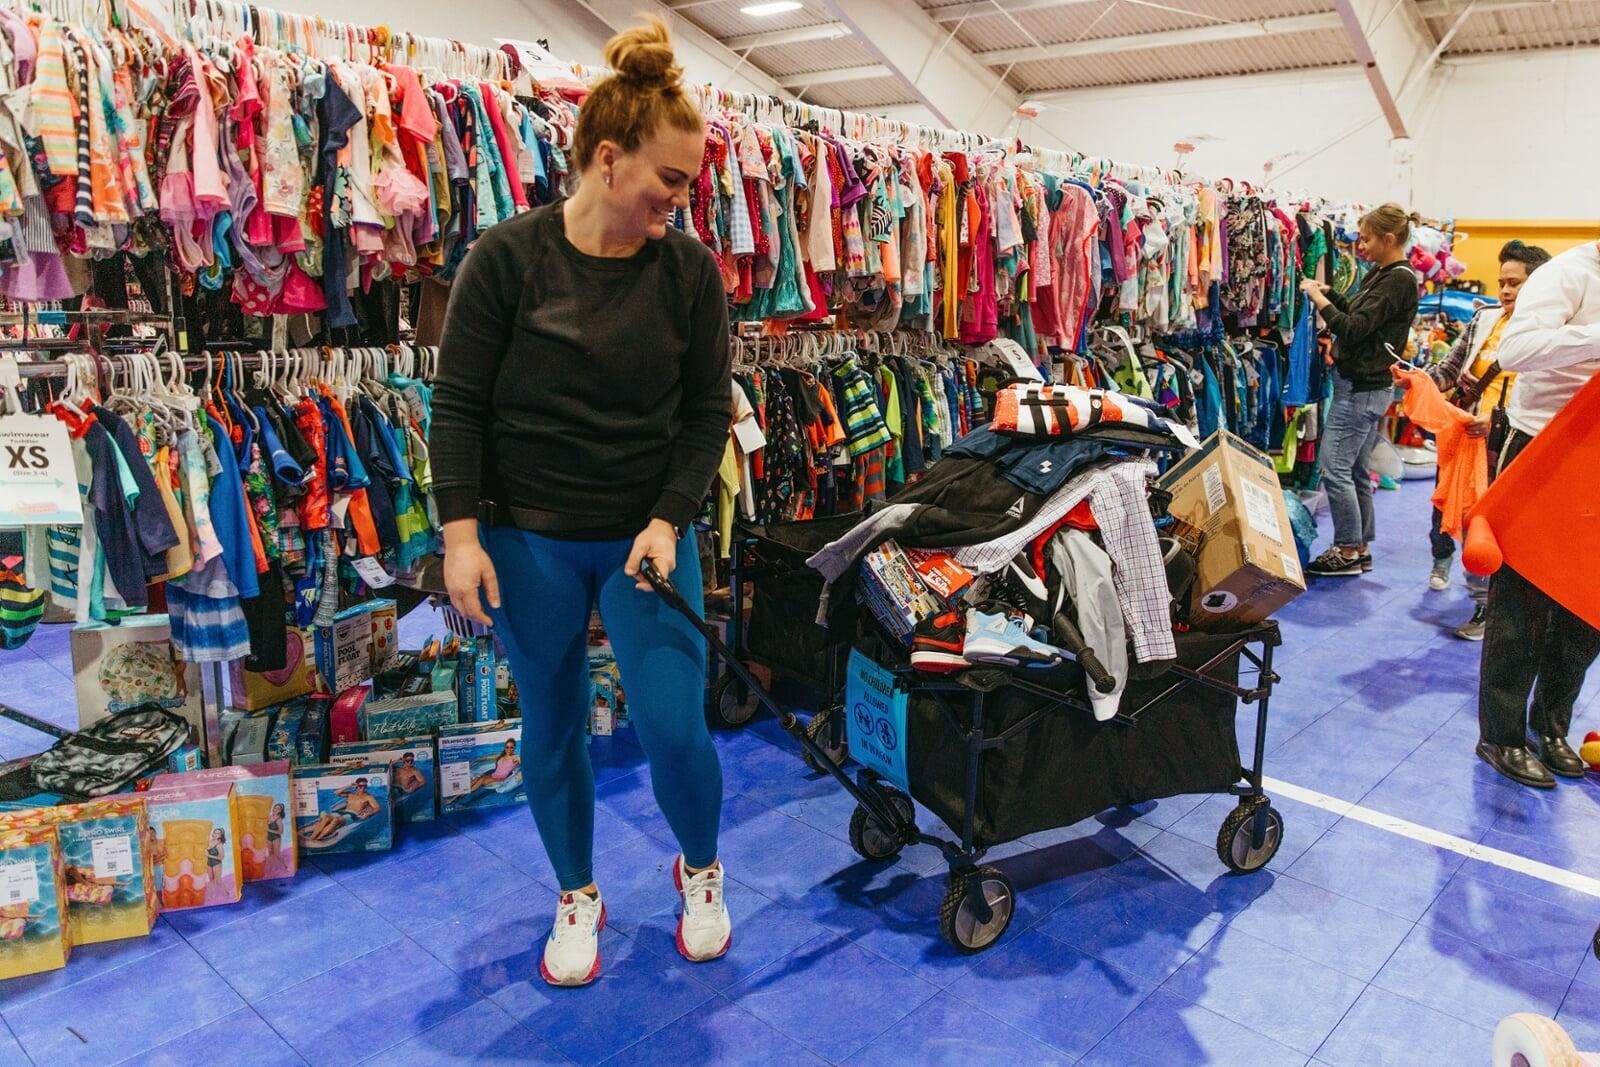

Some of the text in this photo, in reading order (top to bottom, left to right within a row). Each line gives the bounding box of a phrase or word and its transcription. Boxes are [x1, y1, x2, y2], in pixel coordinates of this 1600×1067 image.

[5, 445, 49, 469] XS
[337, 644, 356, 658] POOL
[338, 650, 360, 666] FLOAT
[859, 670, 868, 682] NO
[480, 678, 488, 697] POOL
[863, 691, 889, 714] ALLOWED
